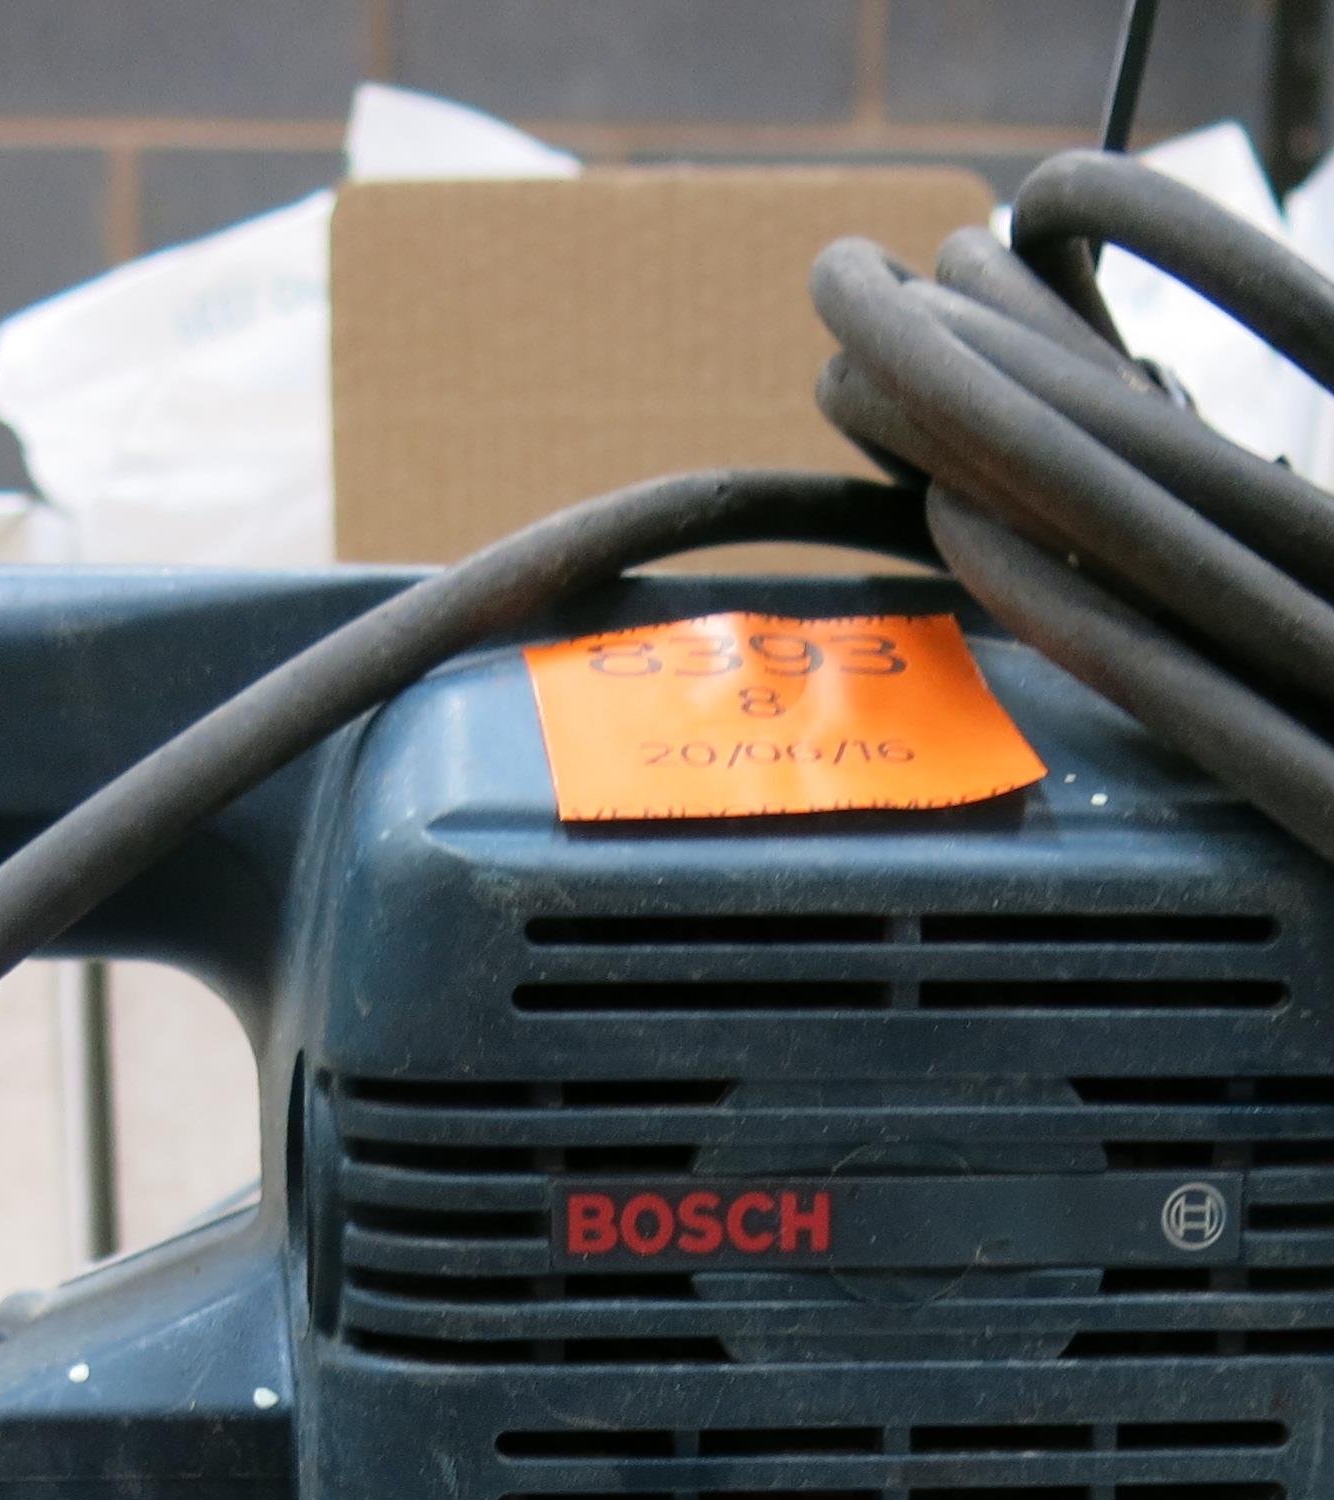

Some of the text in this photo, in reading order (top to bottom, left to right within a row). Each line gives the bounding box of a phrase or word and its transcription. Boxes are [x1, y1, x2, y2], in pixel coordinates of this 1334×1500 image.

[586, 631, 908, 679] 8393
[737, 685, 786, 719] 8
[640, 738, 916, 769] 20/06/16
[566, 1191, 834, 1255] BOSCH
